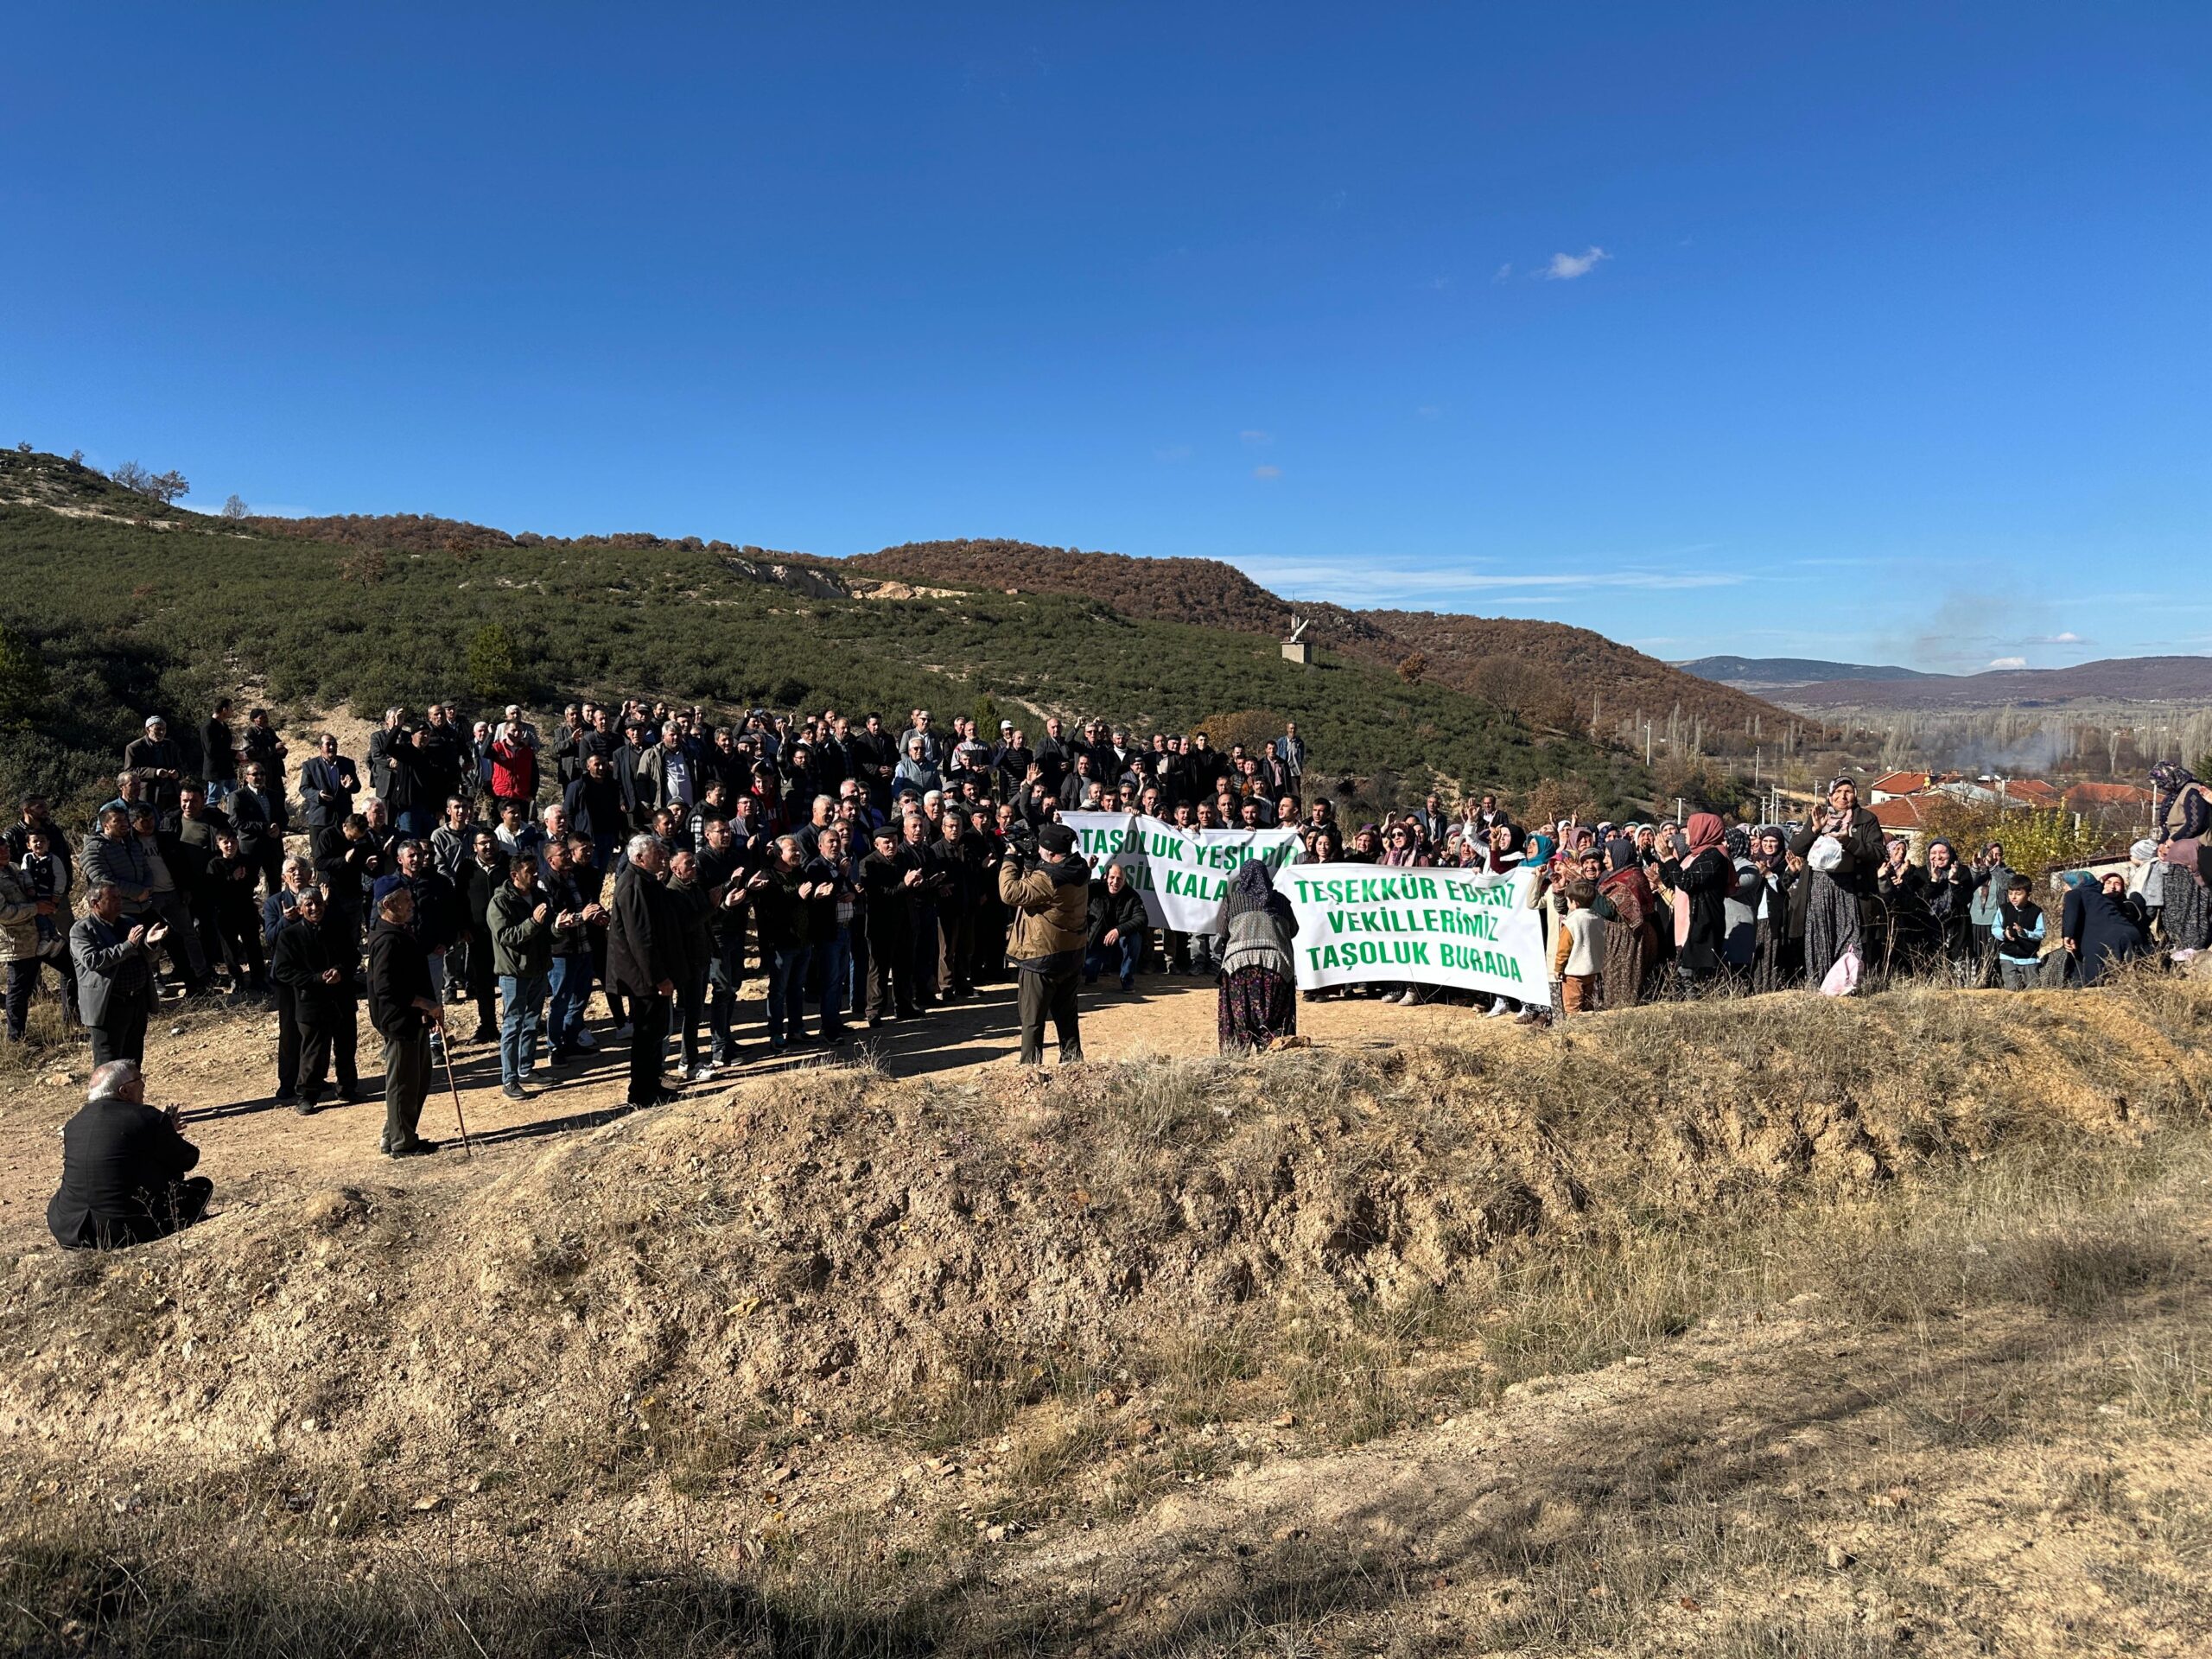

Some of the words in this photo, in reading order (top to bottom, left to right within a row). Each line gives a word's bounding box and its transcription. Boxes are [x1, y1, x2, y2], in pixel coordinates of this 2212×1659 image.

[1080, 829, 1184, 861] TAŞOLUK
[1294, 873, 1438, 905] TEŞEKKÜR
[1327, 906, 1499, 942] VEKİLLERİMİZ
[1306, 941, 1431, 971] TAŞOLUK
[1440, 943, 1523, 983] BURADA
